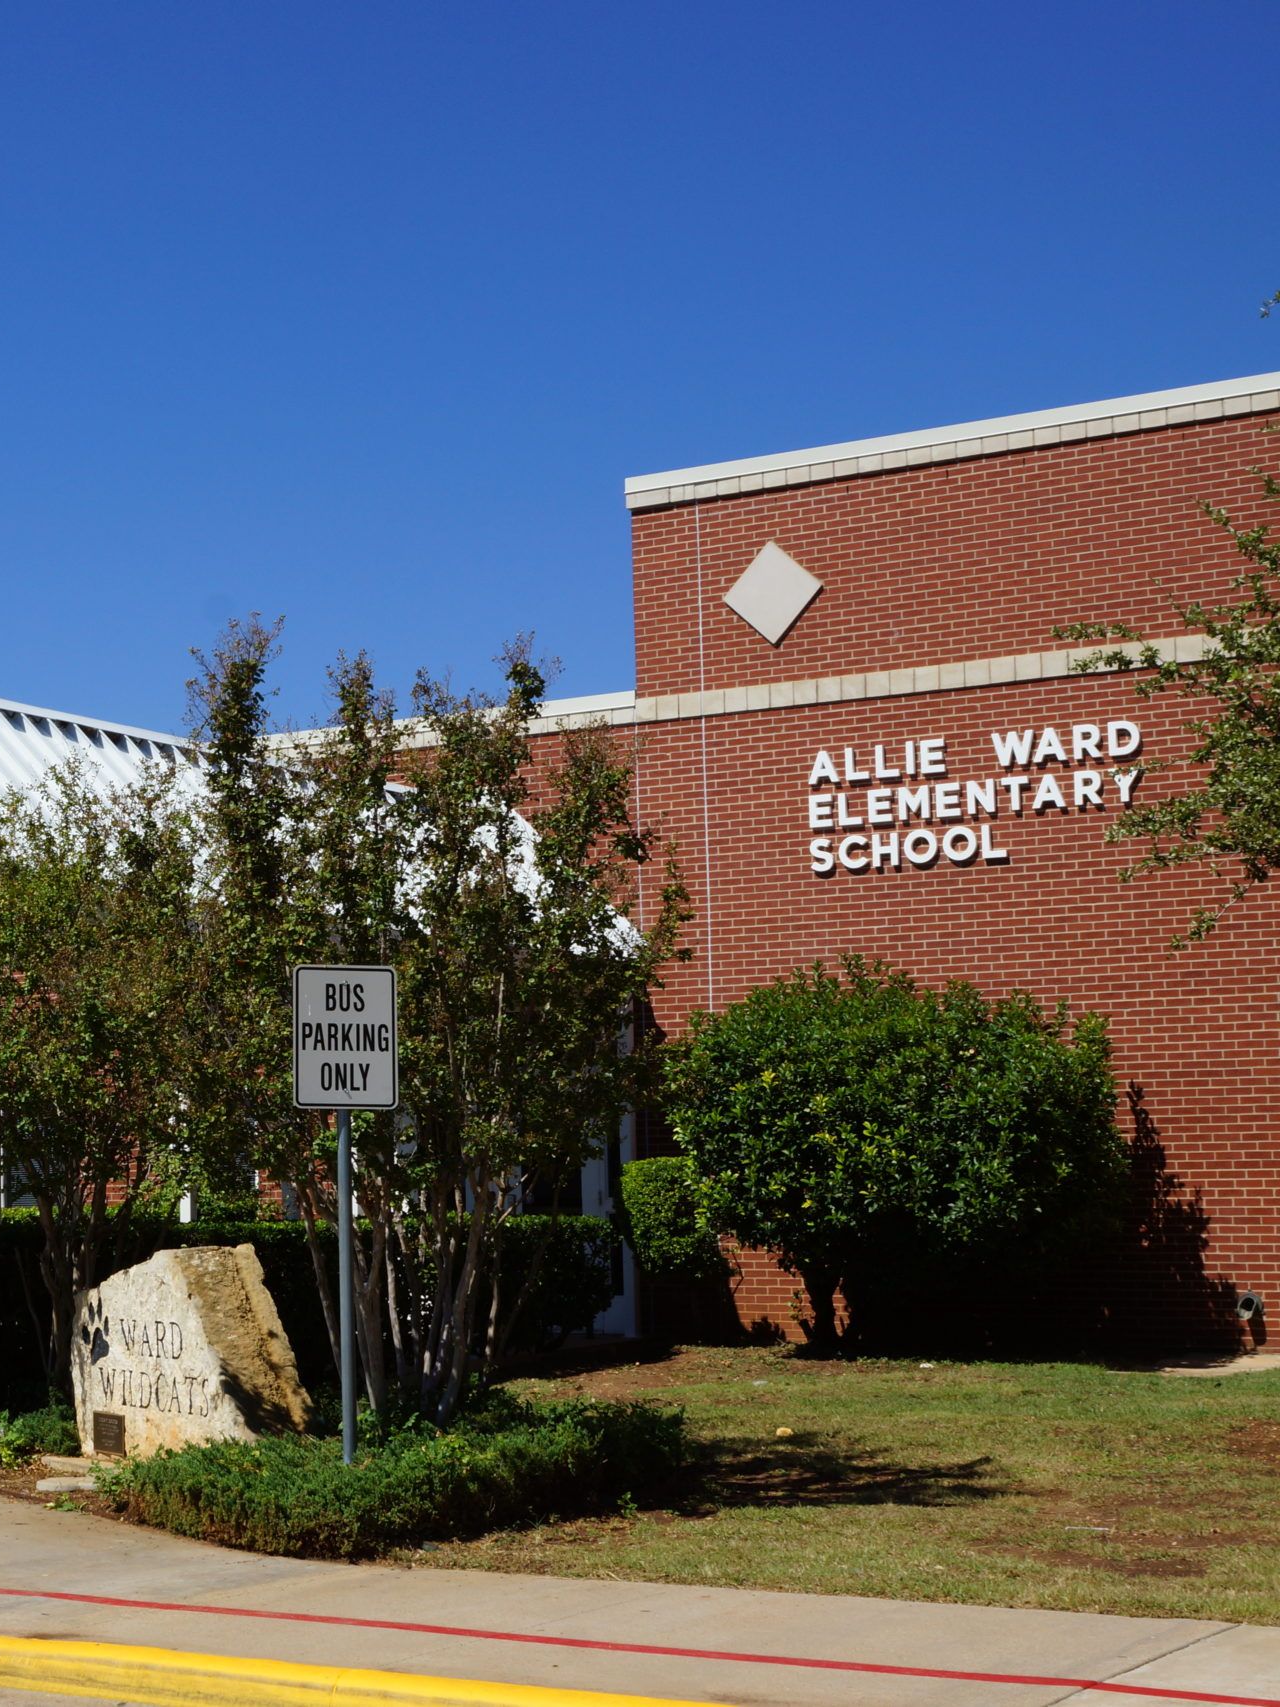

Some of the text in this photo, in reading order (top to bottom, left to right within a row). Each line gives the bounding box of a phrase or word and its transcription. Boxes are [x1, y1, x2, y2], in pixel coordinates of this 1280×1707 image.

[808, 720, 1141, 785] ALLIE WARD
[808, 769, 1143, 829] ELEMENTARY
[809, 824, 1008, 873] SCHOOL
[325, 983, 365, 1012] BUS
[301, 1022, 390, 1053] PARKING
[320, 1062, 370, 1091] ONLY
[119, 1318, 183, 1360] WARD
[98, 1366, 209, 1418] WILDCATS
